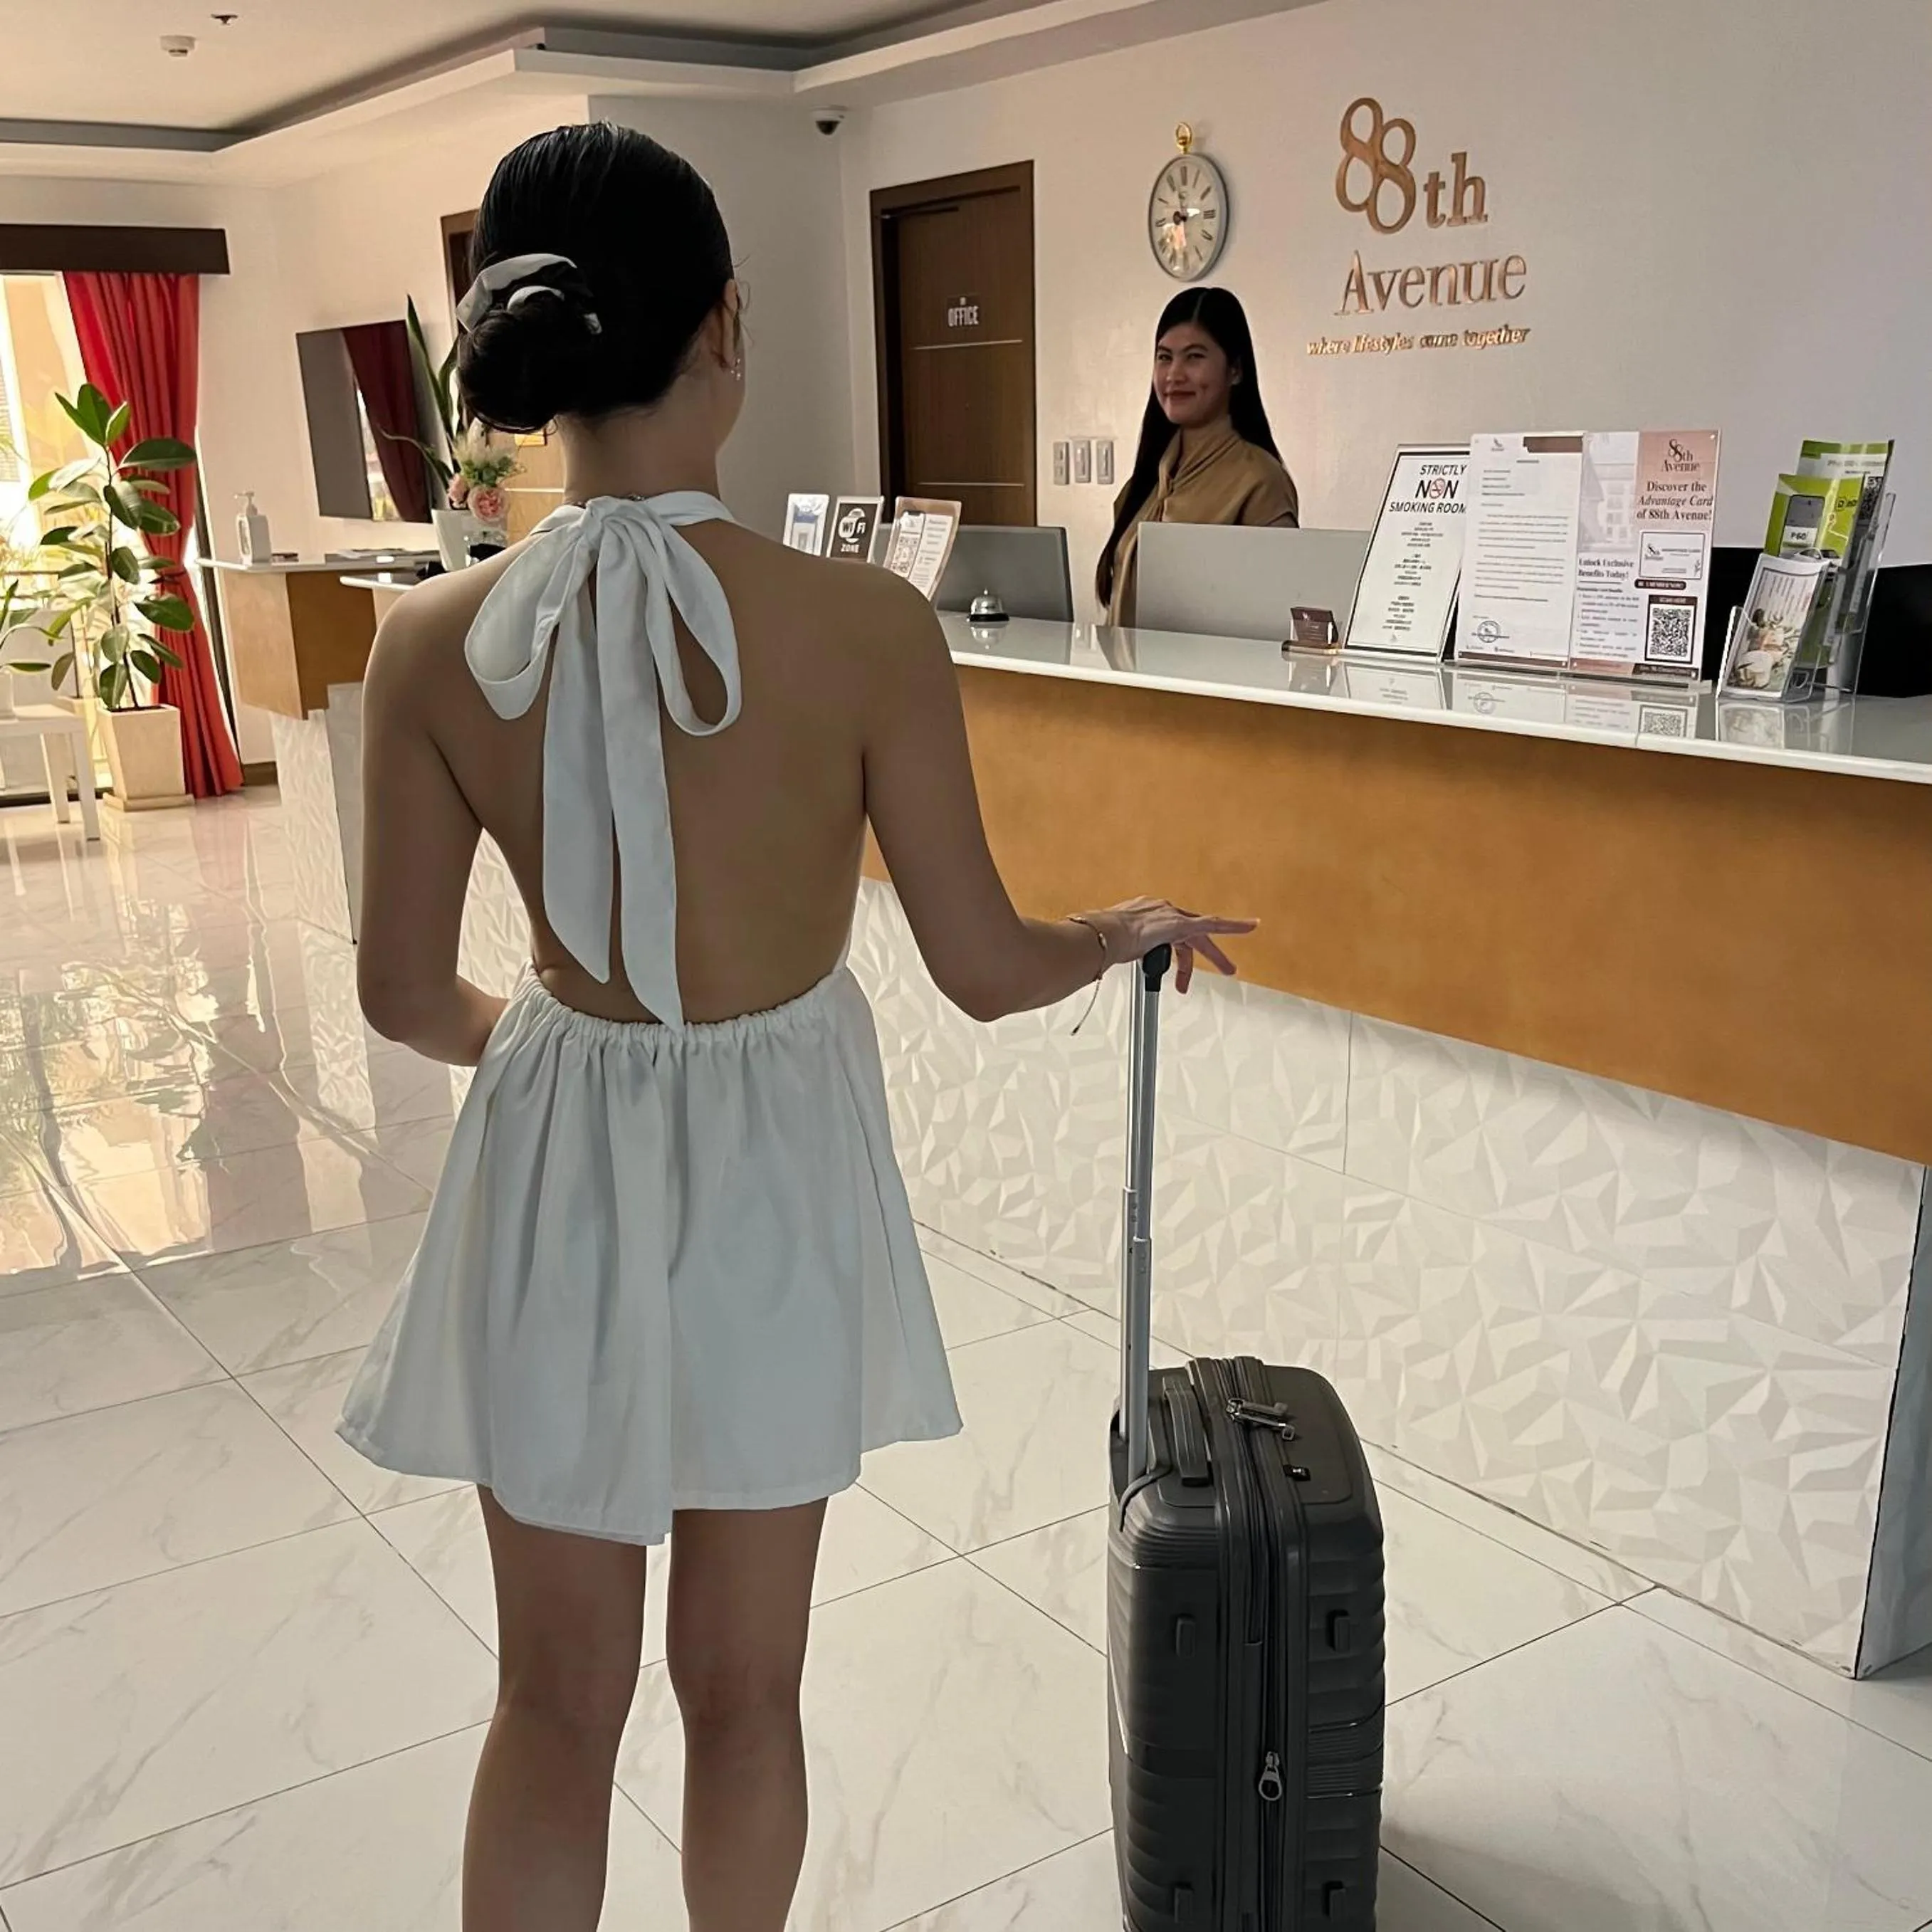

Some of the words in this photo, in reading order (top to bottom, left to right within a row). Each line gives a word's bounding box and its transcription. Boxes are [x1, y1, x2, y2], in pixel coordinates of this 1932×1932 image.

[1335, 98, 1489, 234] 88th
[1333, 250, 1526, 315] Avenue
[947, 305, 979, 327] OFFICE
[1306, 336, 1350, 355] where
[1352, 332, 1414, 355] lifestyles
[1420, 333, 1458, 349] come
[1462, 323, 1531, 350] together
[1419, 464, 1467, 476] STRICTLY
[1661, 459, 1701, 471] Avenue
[1647, 481, 1689, 491] Discover
[1691, 481, 1707, 491] the
[1639, 495, 1687, 507] Advantage
[1689, 495, 1713, 506] Card
[1389, 502, 1434, 513] SMOKING
[1637, 508, 1647, 519] of
[1672, 510, 1712, 520] Avenue!
[841, 544, 860, 553] ZONE
[1603, 559, 1634, 567] Exclusive
[1578, 569, 1604, 577] Benefits
